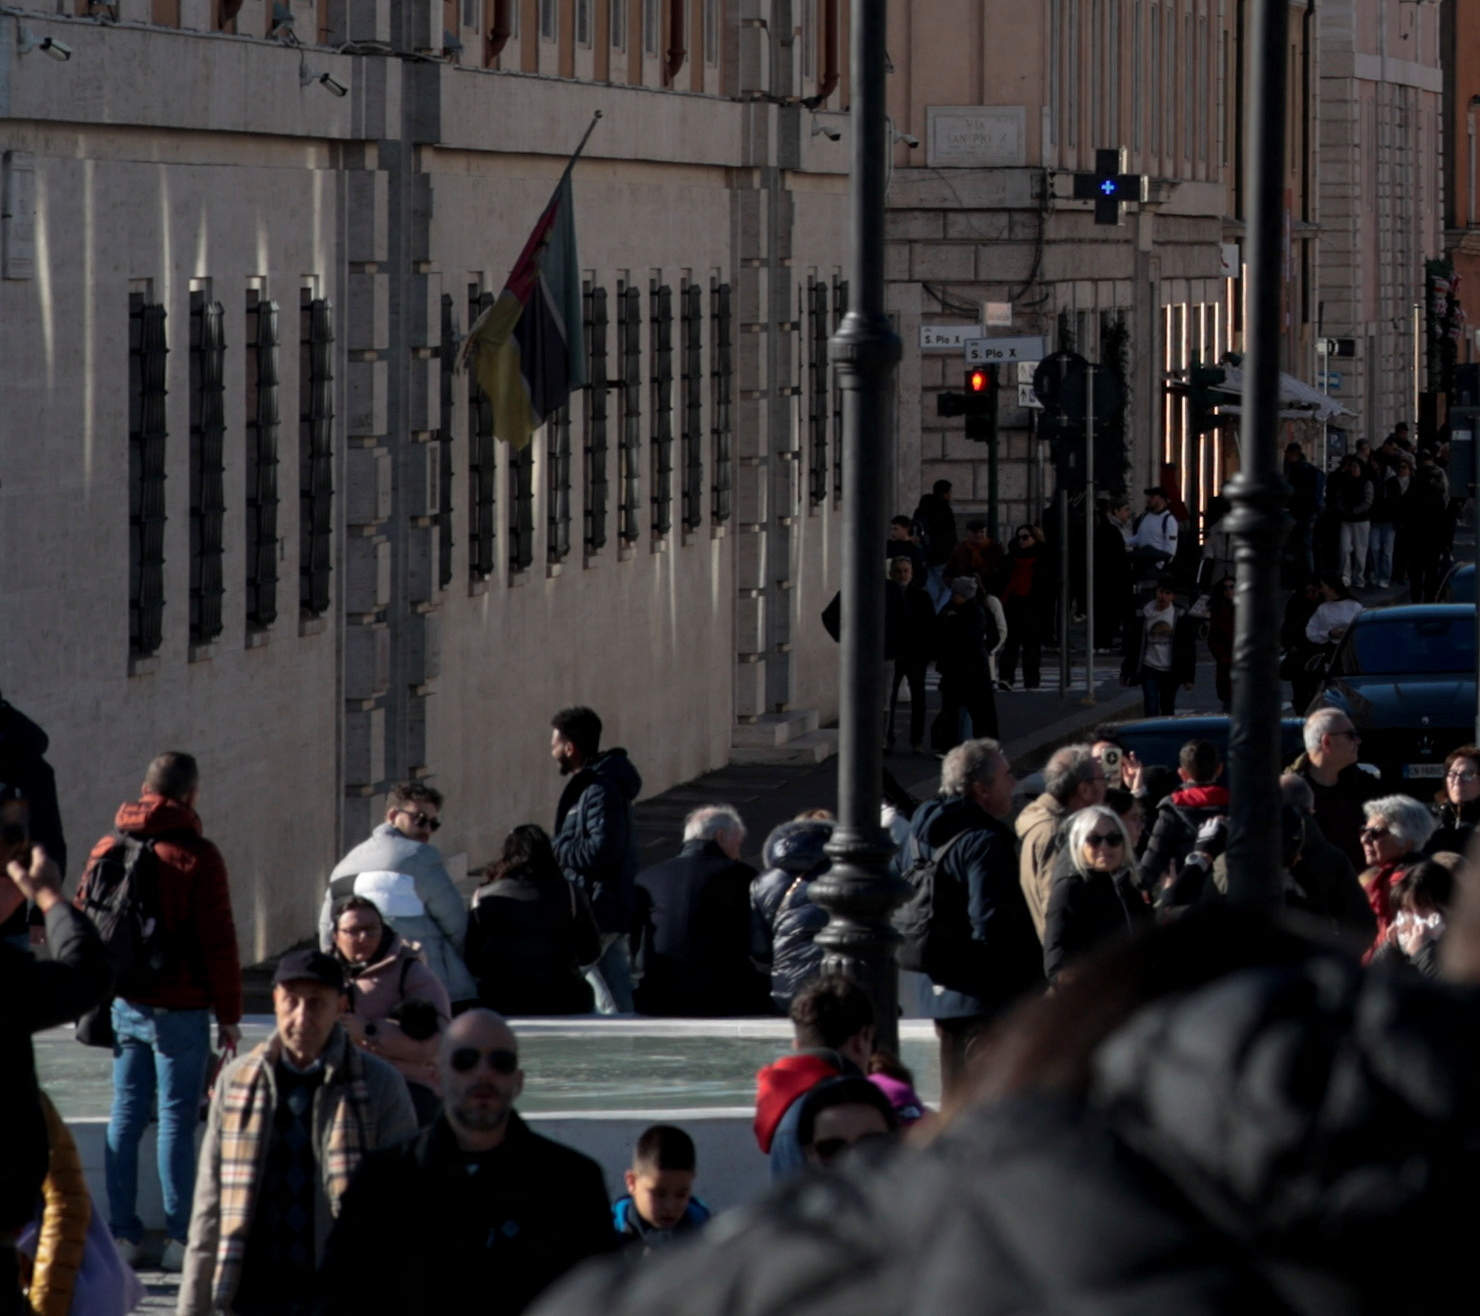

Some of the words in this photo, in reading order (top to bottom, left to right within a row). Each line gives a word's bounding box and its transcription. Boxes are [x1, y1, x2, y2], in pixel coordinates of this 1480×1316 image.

[925, 336, 934, 345] S.
[936, 335, 950, 344] Pio
[954, 335, 961, 344] X
[971, 350, 982, 359] S.
[986, 349, 1003, 358] Pio
[1009, 348, 1016, 357] X
